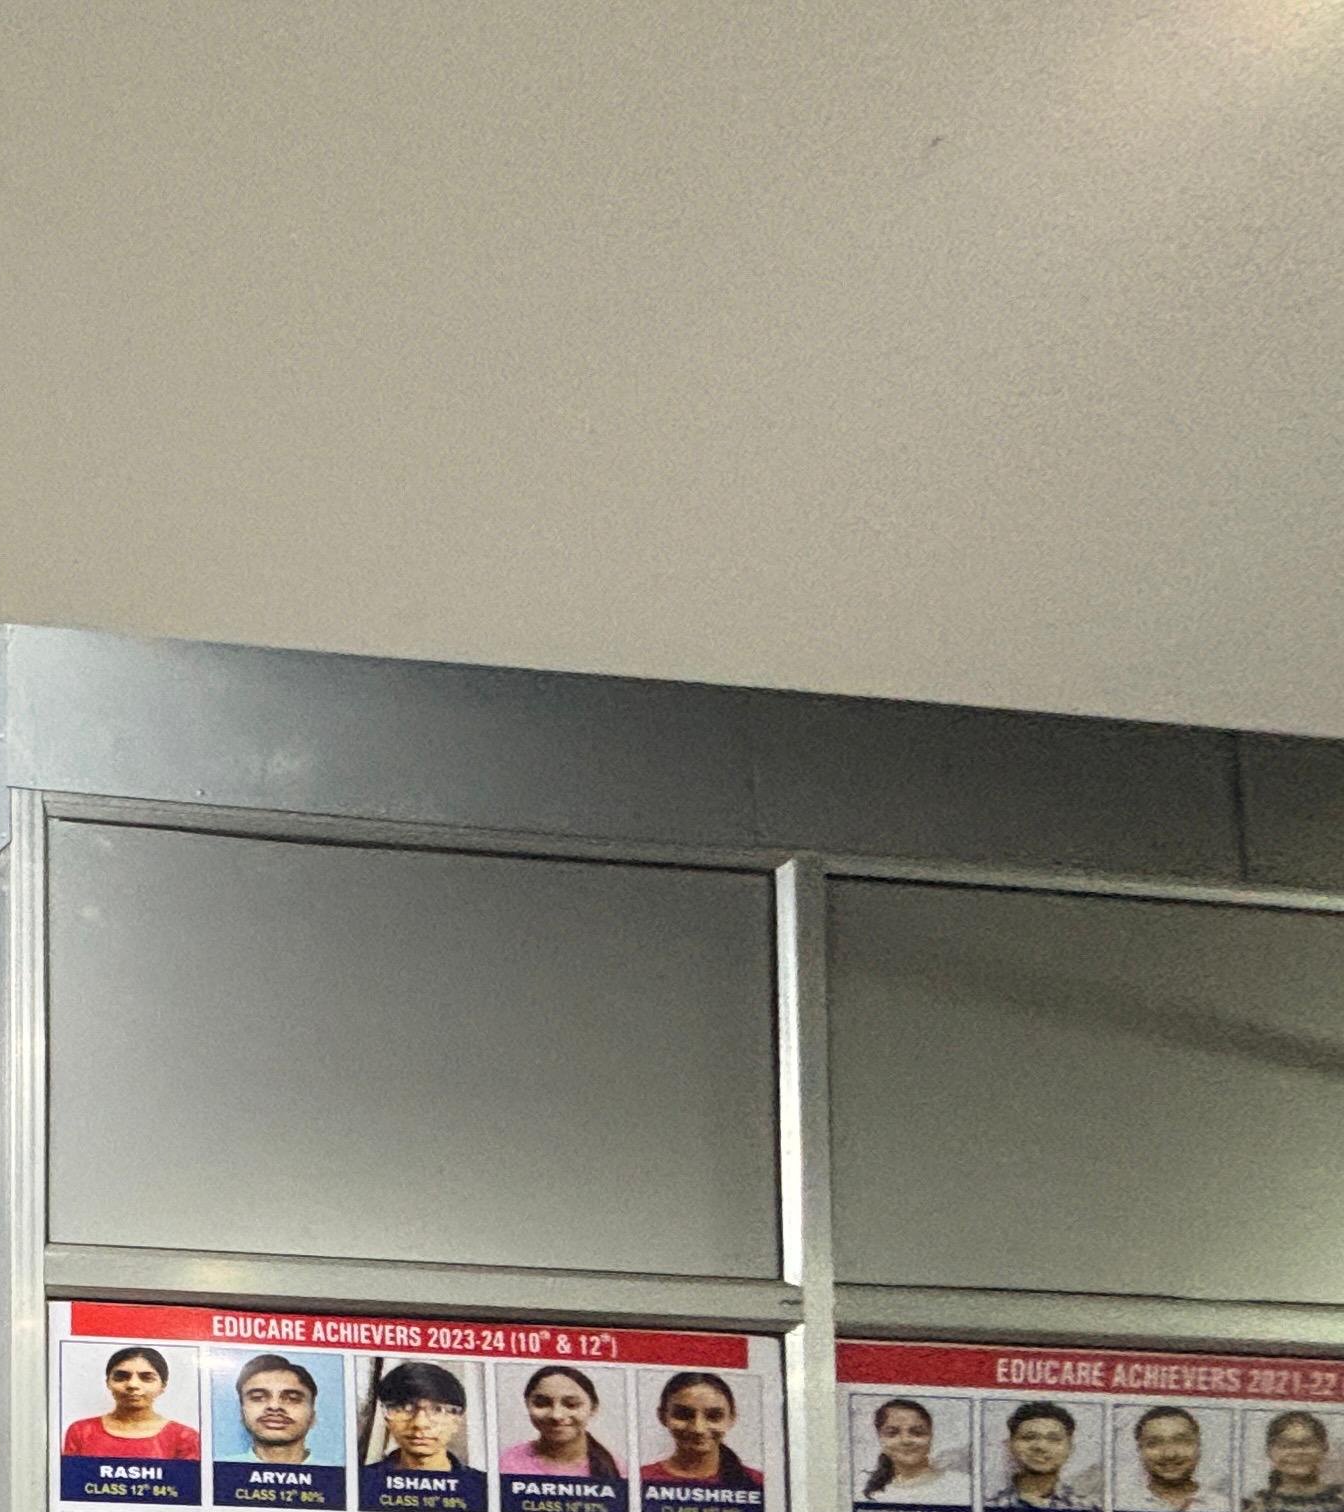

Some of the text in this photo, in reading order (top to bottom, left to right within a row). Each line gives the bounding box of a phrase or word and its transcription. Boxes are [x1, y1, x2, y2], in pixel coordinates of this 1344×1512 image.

[212, 1314, 305, 1342] EDUCARE
[312, 1320, 420, 1348] ACHIEVERS
[427, 1327, 505, 1350] 2023-24
[556, 1333, 571, 1354] &
[997, 1357, 1105, 1387] EDUCARE
[1114, 1362, 1241, 1392] ACHIEVERS
[100, 1465, 163, 1481] RASHI
[249, 1470, 312, 1486] ARYAN
[84, 1482, 127, 1496] CLASS
[386, 1476, 459, 1492] ISHANT
[512, 1481, 616, 1498] PARNIKA
[235, 1488, 276, 1501] CLASS
[379, 1494, 419, 1507] CLASS
[645, 1486, 761, 1505] ANUSHREE
[521, 1499, 561, 1512] CLASS
